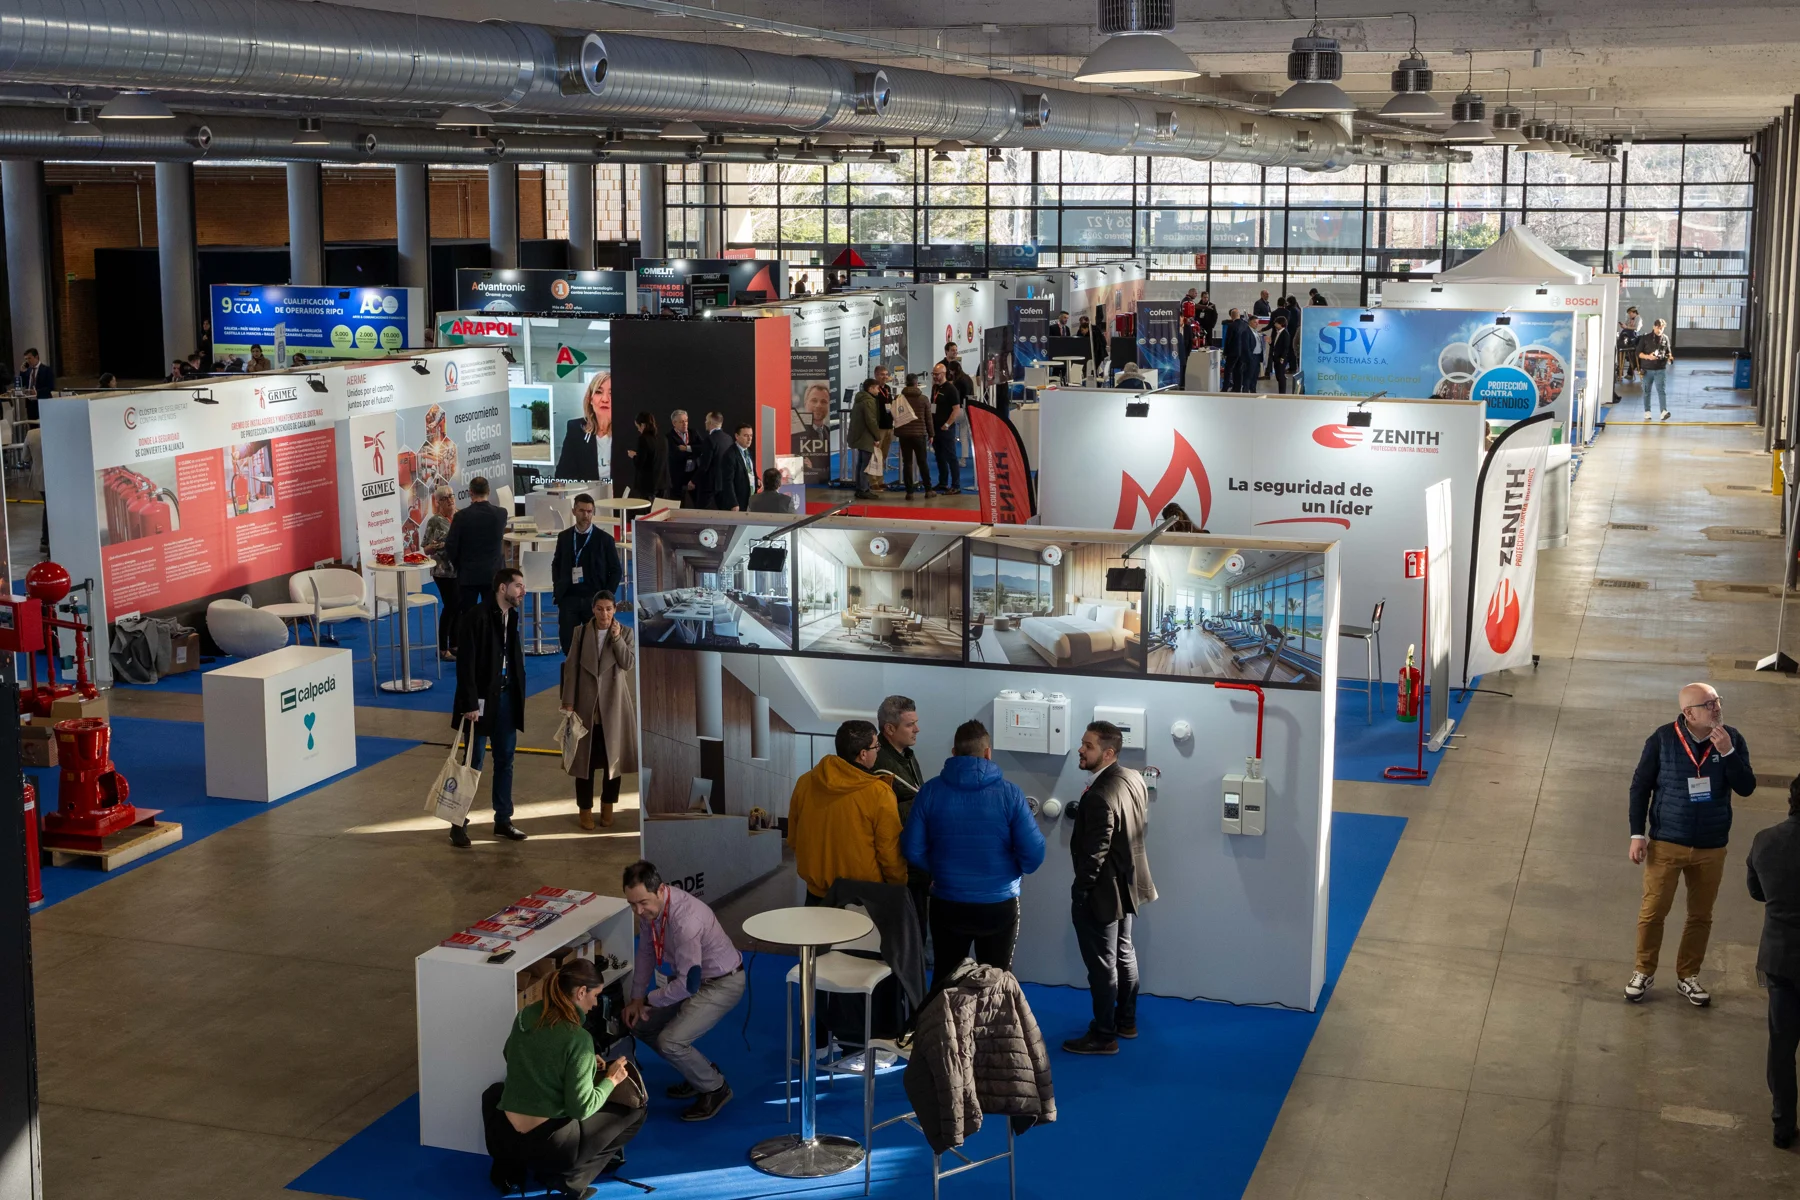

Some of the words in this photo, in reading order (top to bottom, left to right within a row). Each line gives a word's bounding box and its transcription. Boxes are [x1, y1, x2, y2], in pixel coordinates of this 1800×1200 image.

[472, 281, 526, 292] Advantronic
[222, 297, 232, 314] 9
[234, 303, 262, 314] CCAA
[284, 298, 334, 306] CUALIFICACIÓN
[1565, 298, 1598, 306] BOSCH
[884, 313, 905, 324] ALINEADOS
[451, 321, 518, 336] ARAPOL
[890, 326, 904, 336] NUEVO
[1318, 325, 1381, 355] SPV
[884, 343, 899, 357] RIPCI
[346, 374, 366, 386] AERME
[1318, 373, 1348, 381] Ecofire
[1351, 374, 1384, 384] Parking
[1388, 375, 1420, 383] Control
[346, 388, 363, 398] Unidos
[372, 386, 377, 394] el
[1488, 380, 1528, 391] PROTECCIÓN
[268, 388, 297, 401] GRIMEC
[347, 399, 362, 411] juntos
[362, 398, 370, 407] por
[455, 406, 498, 424] asesoramiento
[250, 417, 275, 427] INSTALADORES
[139, 437, 152, 446] DONDE
[158, 432, 179, 443] SEGURIDAD
[466, 423, 502, 443] defensa
[1372, 429, 1440, 446] ZENITH
[135, 449, 140, 457] SE
[141, 446, 162, 457] CONVIERTE
[168, 442, 184, 451] ALIANZA
[468, 442, 490, 456] protección
[800, 440, 828, 452] KPI
[466, 456, 480, 467] contra
[480, 452, 501, 464] incendios
[362, 481, 395, 497] GRIMEC
[1229, 478, 1248, 492] La
[1254, 480, 1345, 496] seguridad
[1350, 482, 1373, 496] de
[1302, 501, 1325, 513] un
[1331, 500, 1373, 515] líder
[368, 517, 394, 528] Recargadors
[1500, 469, 1526, 566] ZENITH
[370, 535, 395, 547] Mantenidors
[298, 676, 336, 702] calpeda
